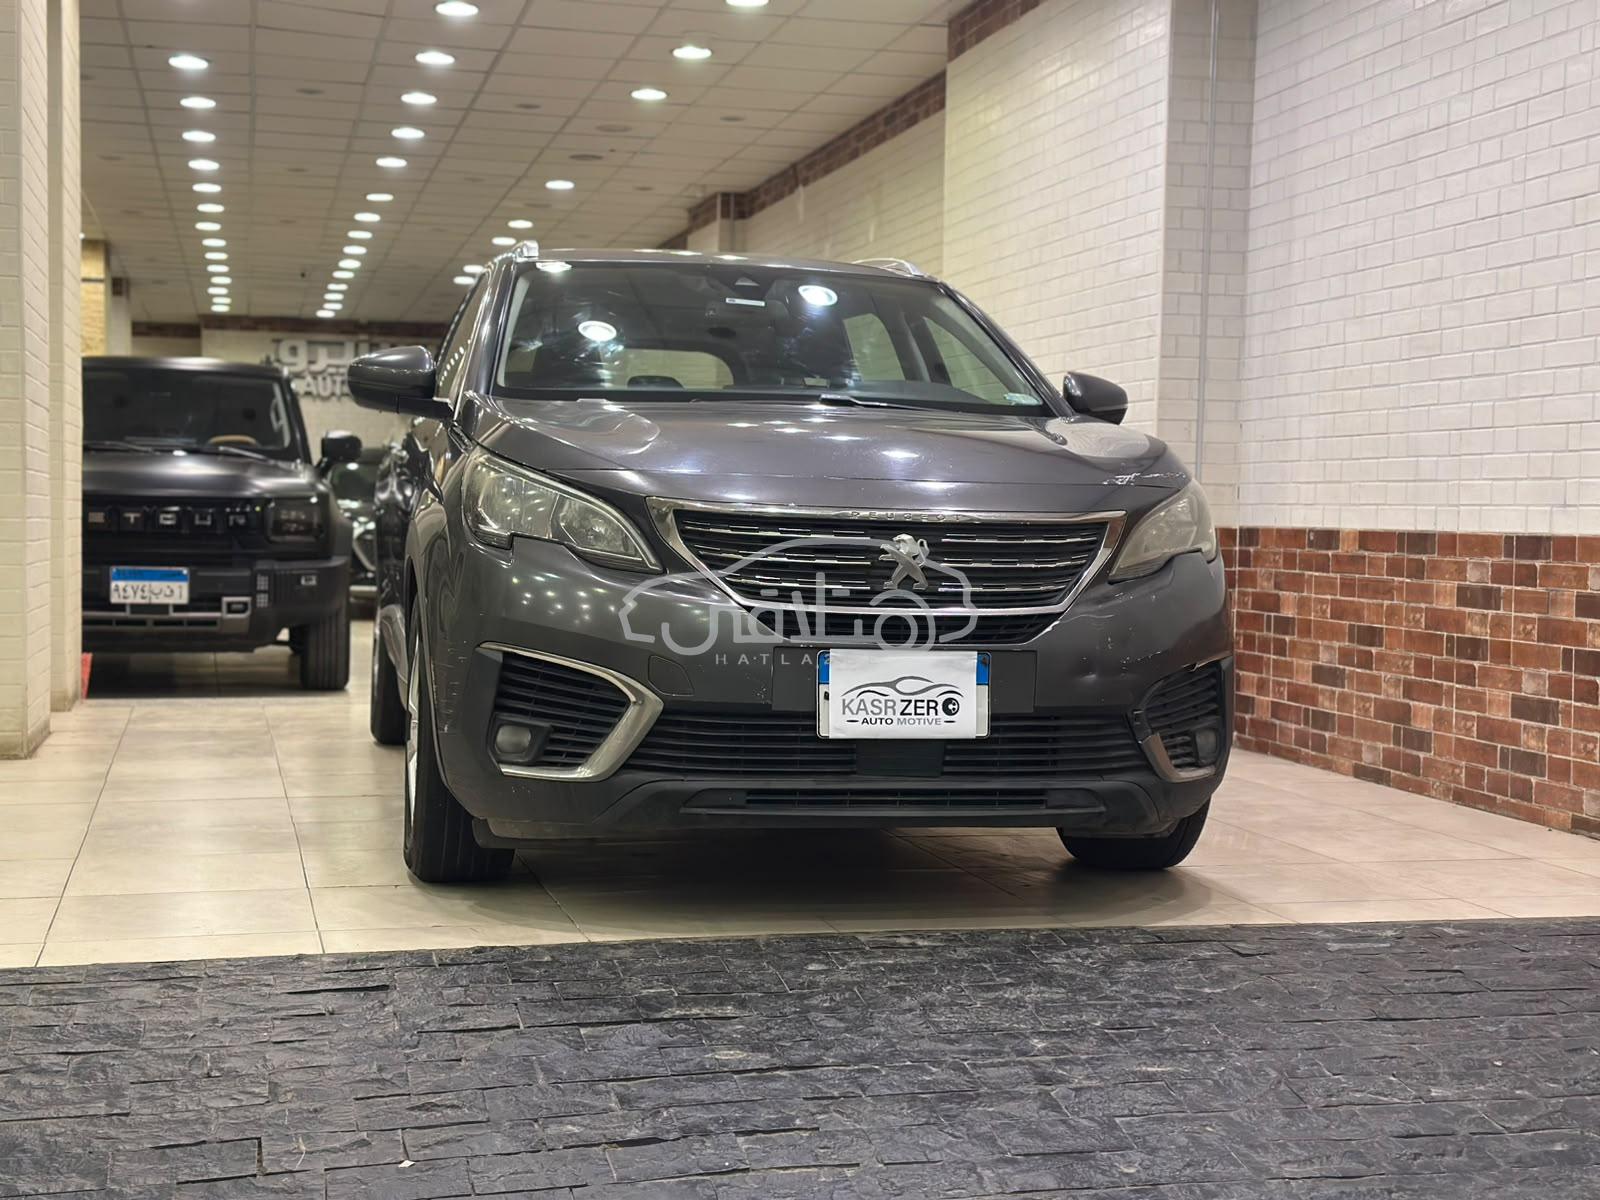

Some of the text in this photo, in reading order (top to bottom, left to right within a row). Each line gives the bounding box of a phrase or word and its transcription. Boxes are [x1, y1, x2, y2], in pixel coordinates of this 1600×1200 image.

[300, 375, 350, 398] AUT
[850, 509, 962, 523] PEUGEOT
[841, 698, 896, 716] KASR
[861, 717, 942, 726] AUTO MOTIVE
